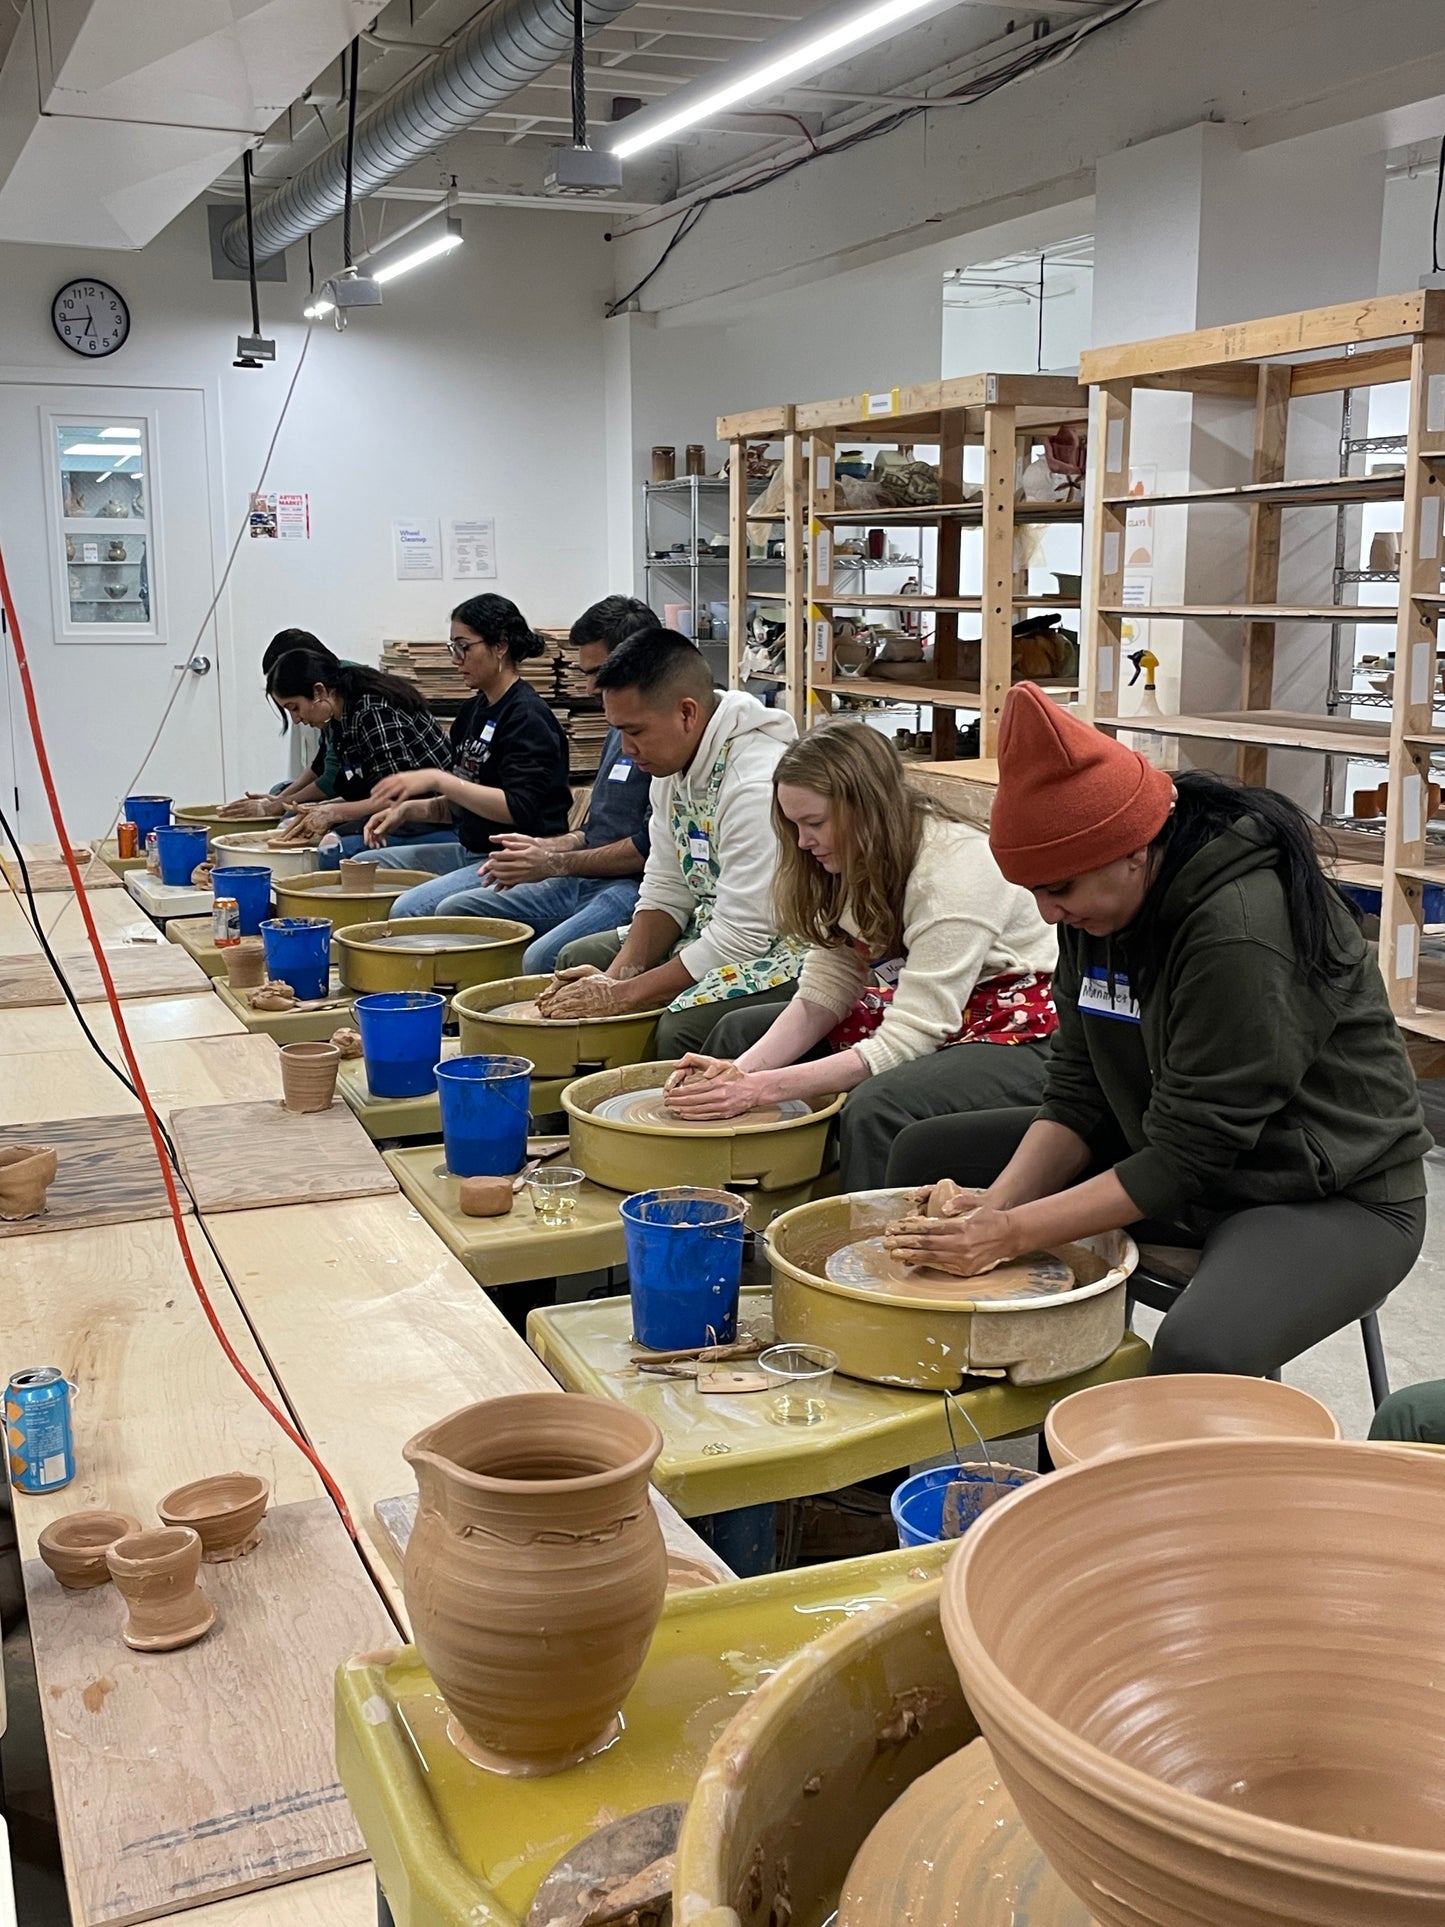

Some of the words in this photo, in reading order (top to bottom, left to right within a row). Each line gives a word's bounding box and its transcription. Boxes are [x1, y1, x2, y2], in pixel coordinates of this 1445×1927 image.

[72, 289, 82, 299] 11
[84, 287, 95, 297] 12
[100, 291, 104, 300] 1
[63, 299, 74, 309] 10
[109, 300, 117, 310] 2
[59, 312, 66, 322] 9
[115, 315, 122, 325] 3
[64, 325, 71, 335] 8
[112, 328, 118, 338] 4
[75, 335, 82, 345] 7
[102, 337, 110, 347] 5
[89, 340, 96, 351] 6
